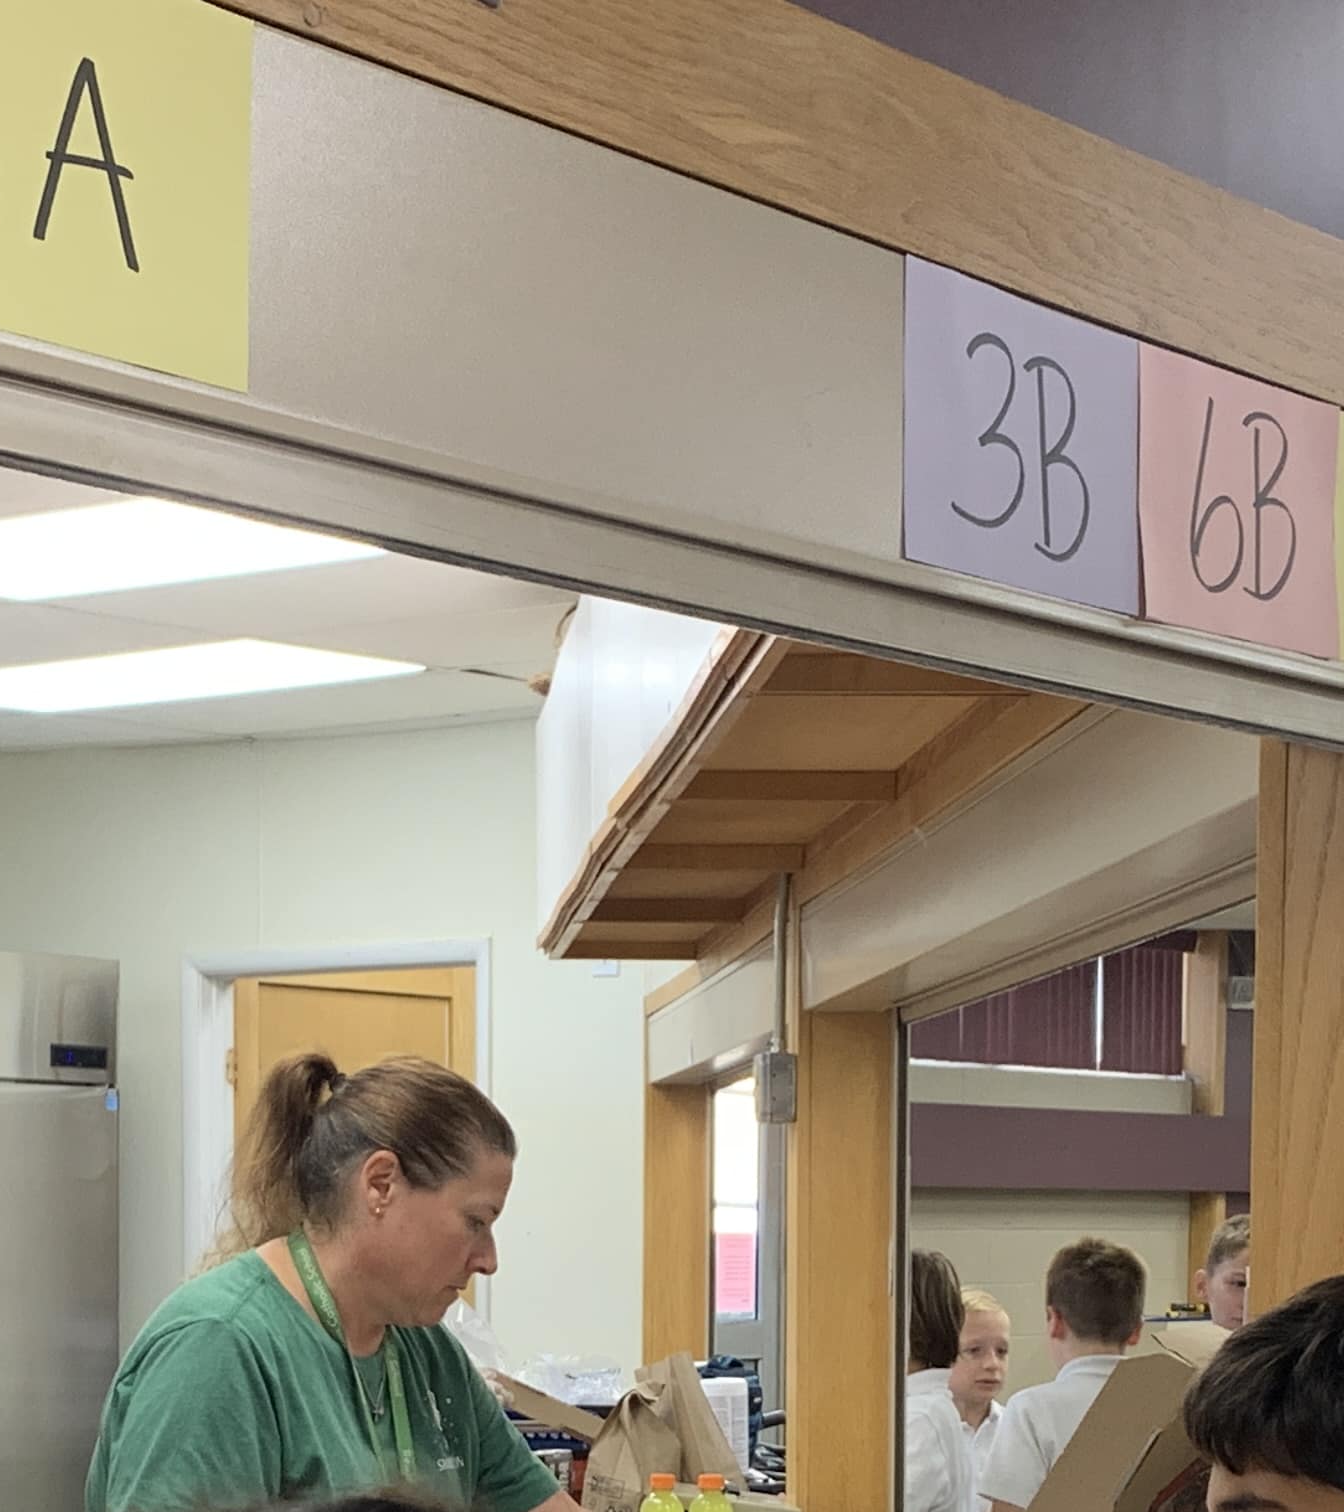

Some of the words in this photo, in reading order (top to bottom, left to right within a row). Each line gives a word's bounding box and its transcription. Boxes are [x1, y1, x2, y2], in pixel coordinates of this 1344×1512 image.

[951, 332, 1091, 563] 3B
[1189, 396, 1297, 602] 6B
[313, 1279, 338, 1328] Catholic
